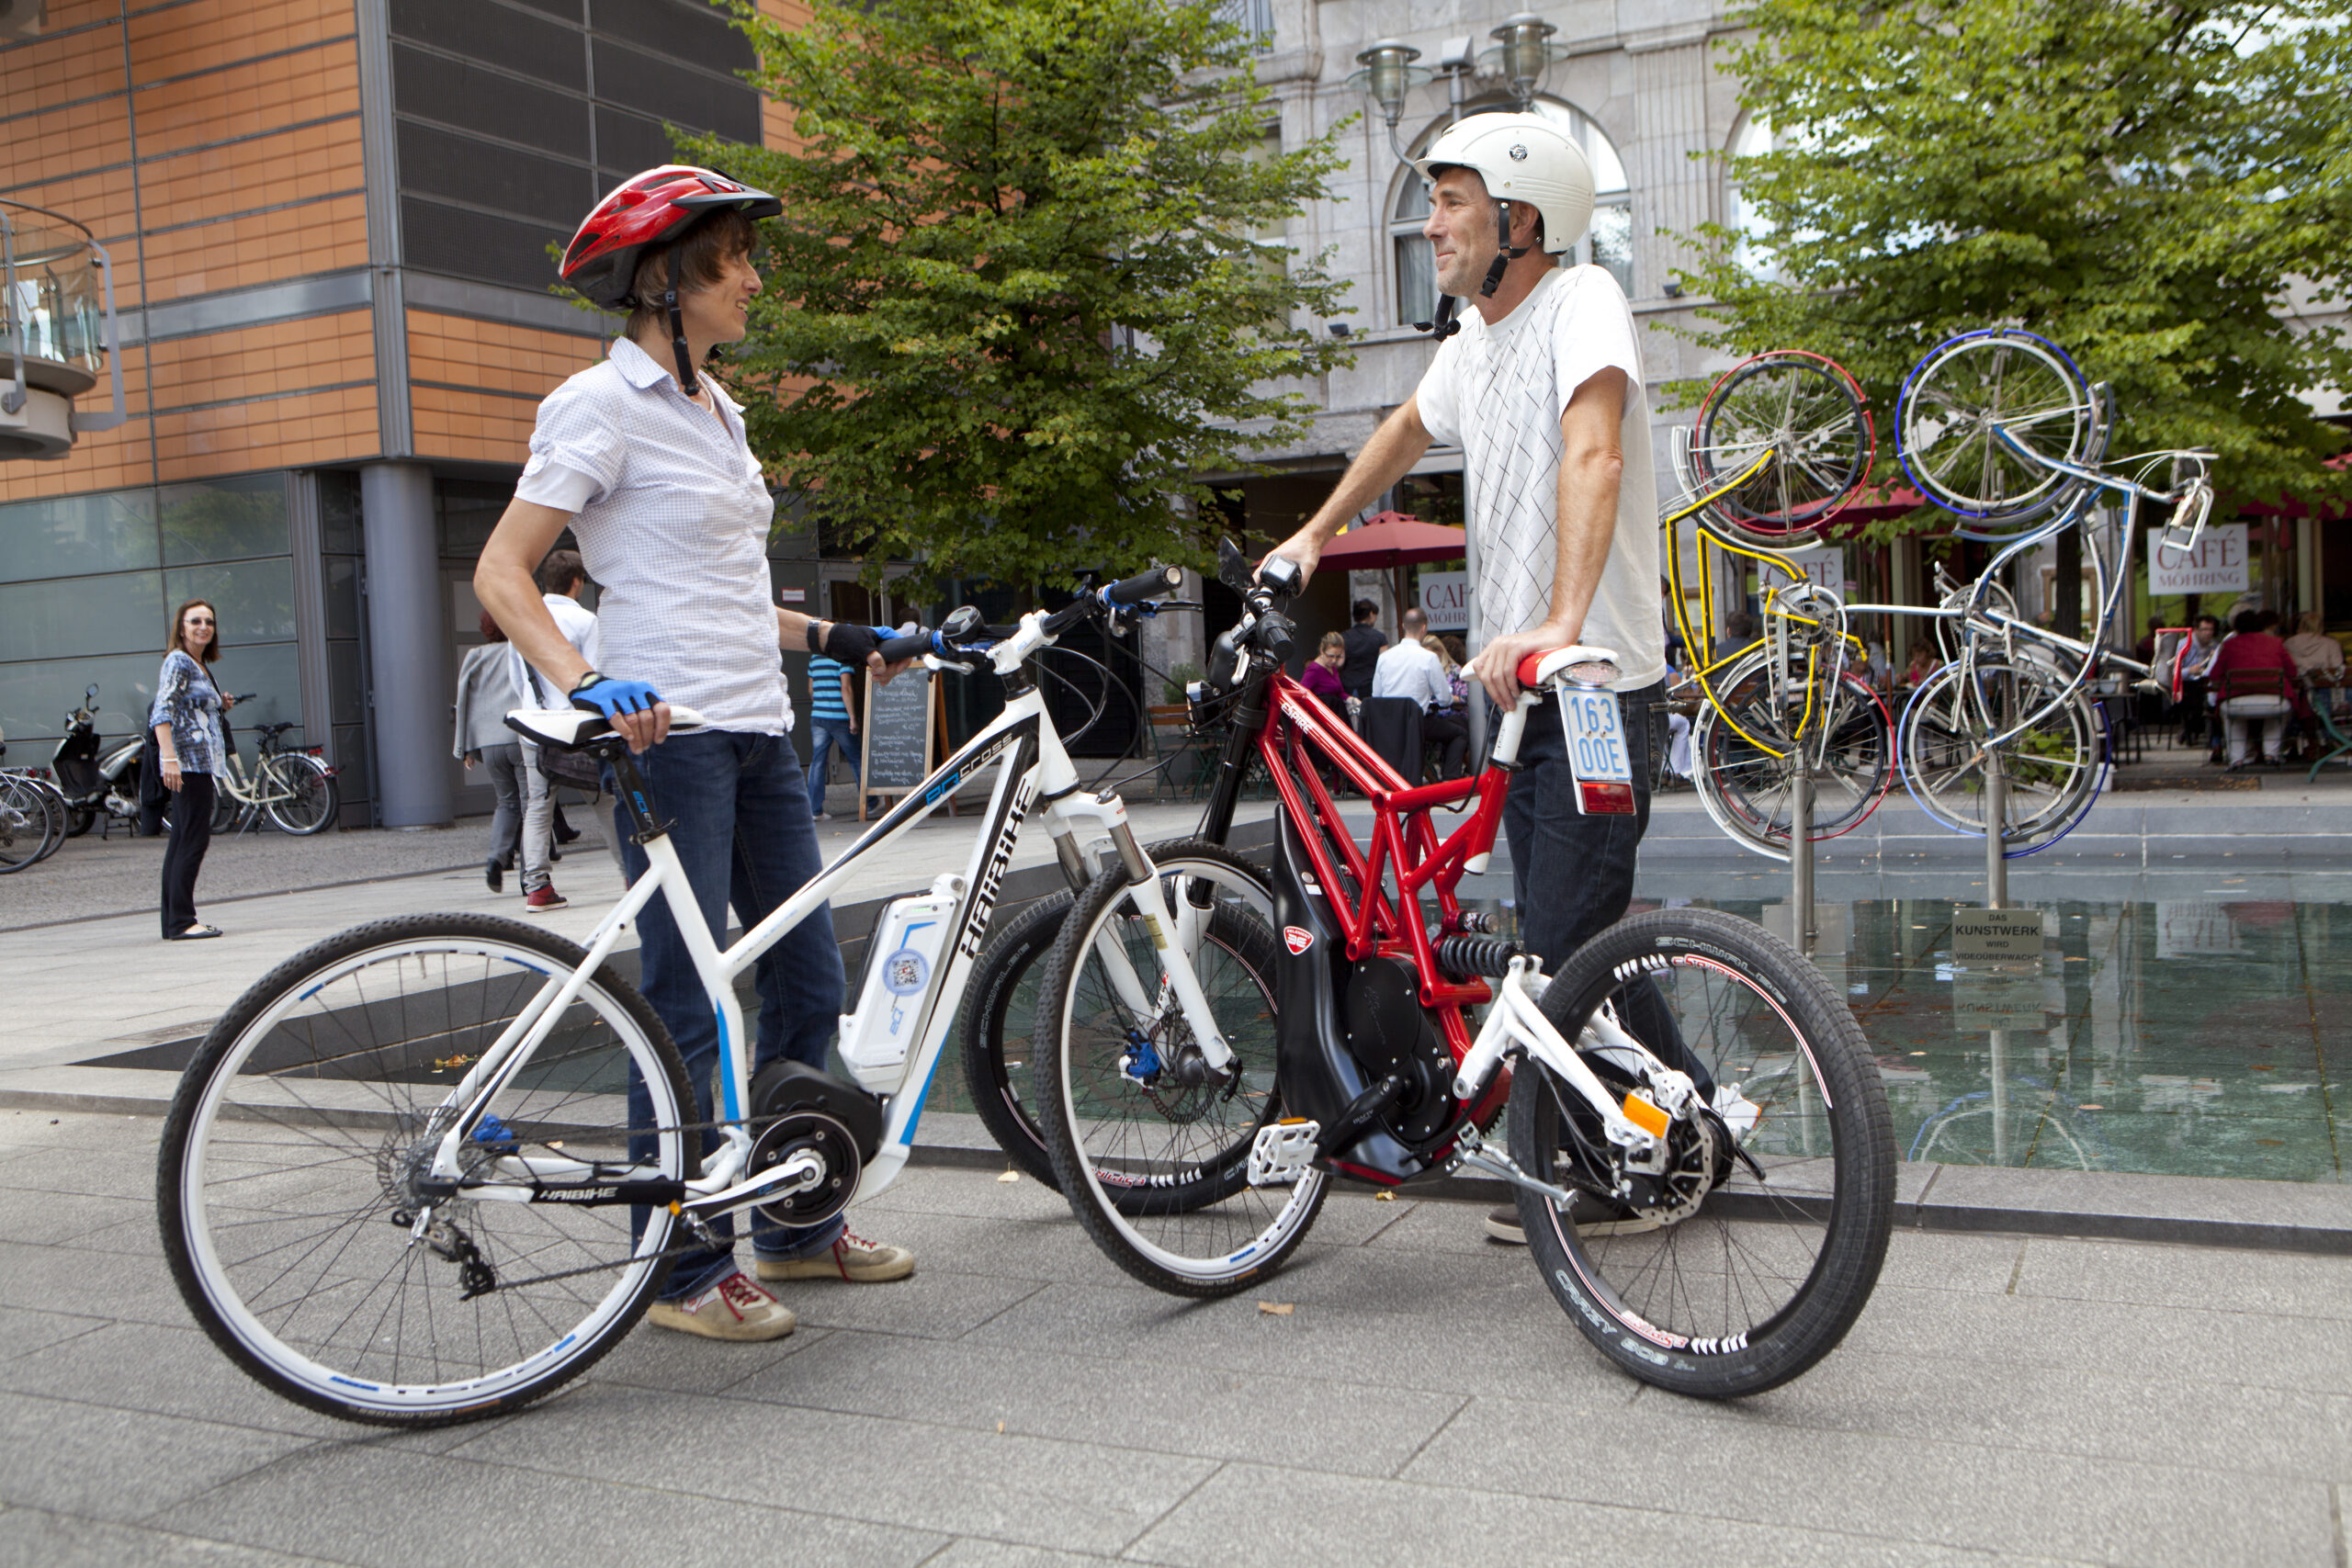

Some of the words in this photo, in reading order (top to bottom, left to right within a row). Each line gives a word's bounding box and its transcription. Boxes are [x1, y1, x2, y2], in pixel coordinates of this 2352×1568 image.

[2156, 529, 2243, 570] CAFÉ
[1426, 582, 1468, 610] CAF
[2159, 570, 2240, 588] MÖHRING
[1571, 696, 1615, 733] 163
[1955, 926, 2039, 936] KUNSTWERK
[1655, 936, 1787, 1004] SCHWALBE
[979, 942, 1030, 1049] SCHWALBE
[538, 1186, 618, 1201] HAIBIKE
[1555, 1269, 1618, 1334] CRAZY
[1621, 1337, 1669, 1366] BOB
